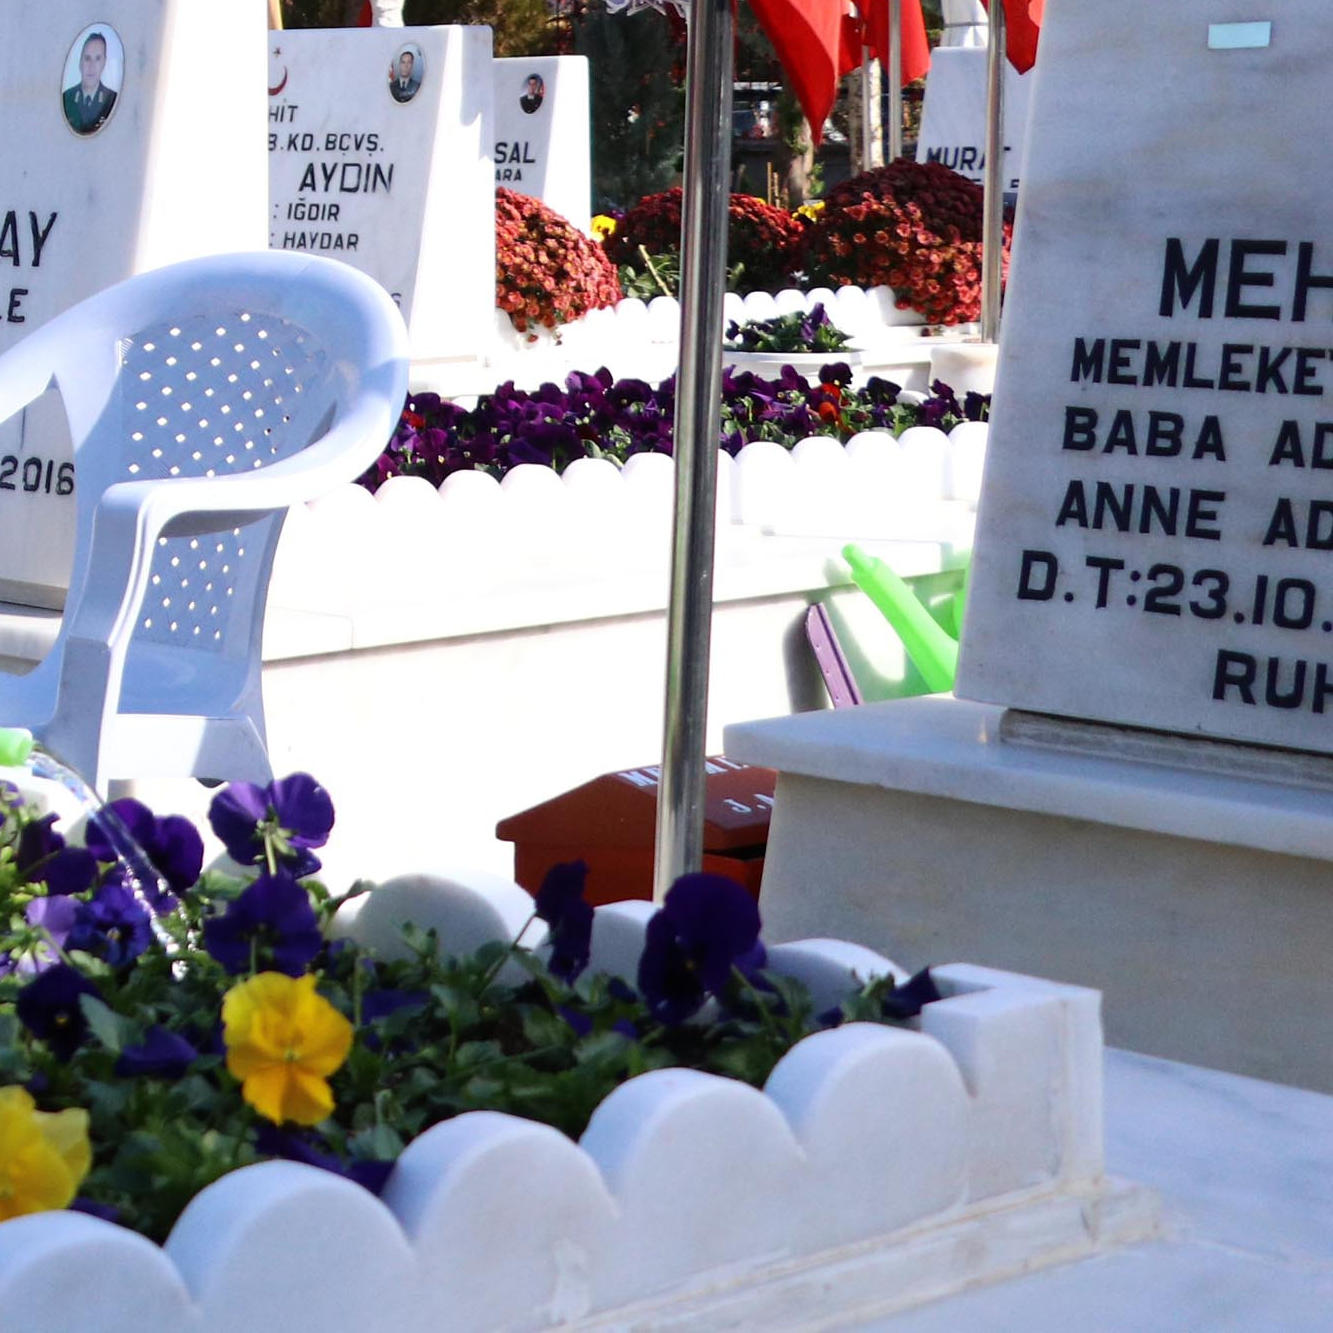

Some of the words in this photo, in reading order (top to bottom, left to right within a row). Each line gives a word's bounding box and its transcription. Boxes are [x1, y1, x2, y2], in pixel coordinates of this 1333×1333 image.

[298, 162, 395, 194] AYDIN
[286, 197, 341, 222] IĞDIR
[283, 231, 360, 251] HAYDAR
[1069, 336, 1333, 396] MEMLEKE
[1062, 405, 1227, 462] BABA
[1055, 479, 1227, 541] ANNE
